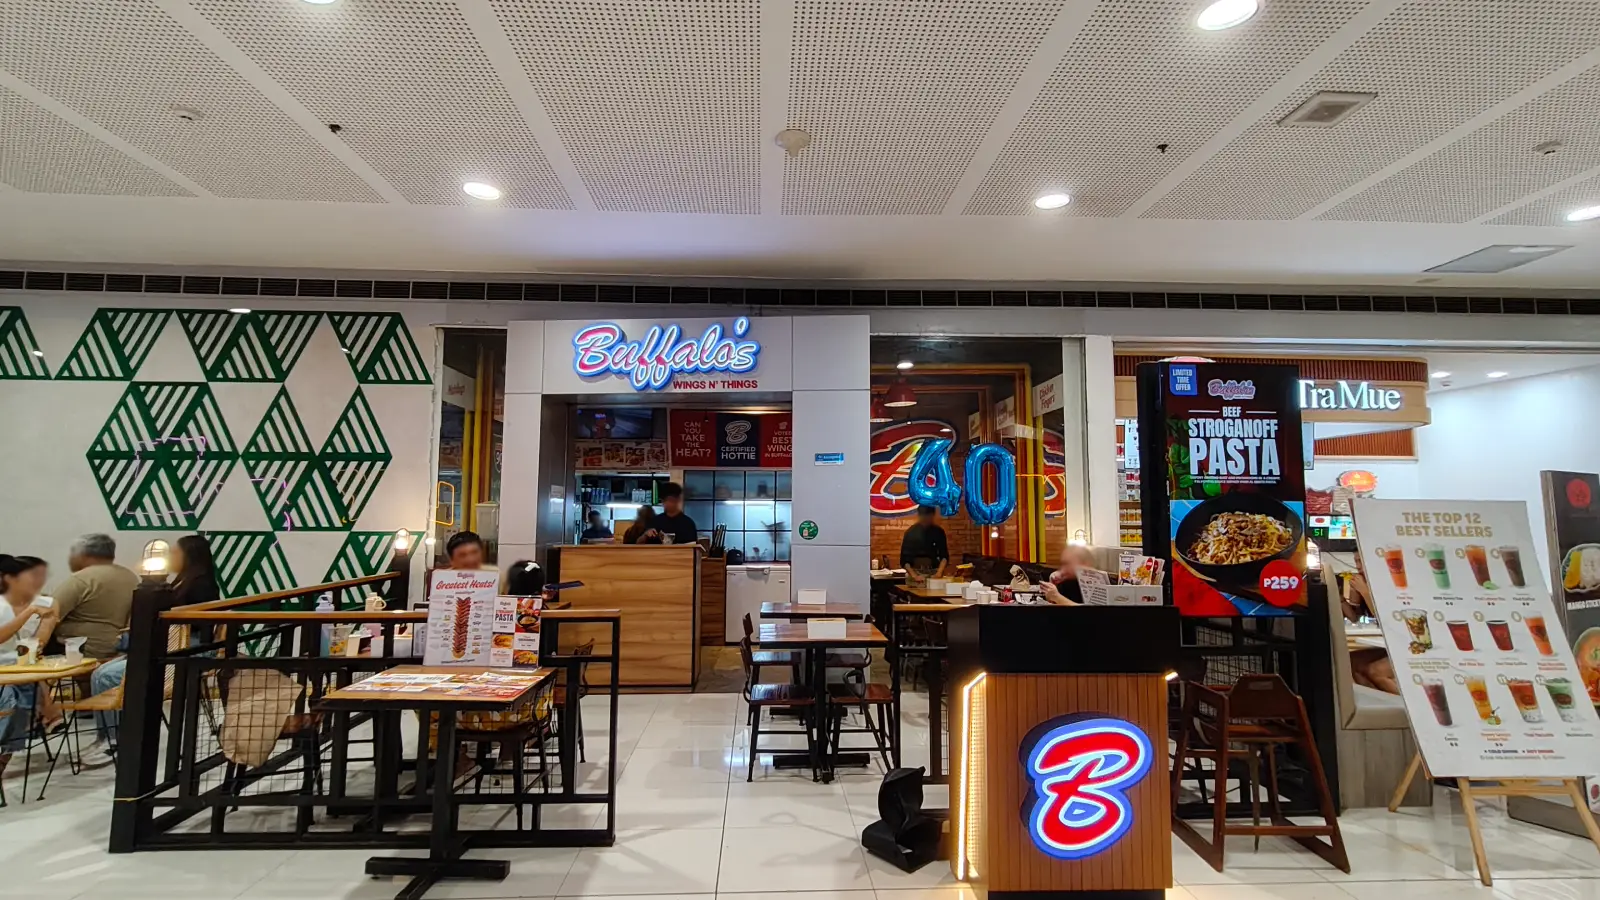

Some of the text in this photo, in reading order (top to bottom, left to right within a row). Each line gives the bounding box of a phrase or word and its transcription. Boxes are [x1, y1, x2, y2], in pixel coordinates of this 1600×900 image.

[573, 316, 760, 390] Buffalo's
[673, 380, 758, 389] WINGS N' THINGS
[1222, 406, 1242, 418] BEEF
[1188, 418, 1279, 438] STROGANOFF
[681, 434, 706, 442] TAKE
[676, 448, 712, 457] HEAT?
[721, 452, 756, 460] HOTTIE
[1189, 438, 1281, 476] PASTA
[1402, 512, 1481, 524] THE TOP 12
[1314, 528, 1325, 537] 51
[1395, 525, 1493, 538] BEST SELLERS
[436, 579, 496, 590] Greatest Heats!
[495, 613, 514, 622] PASTA
